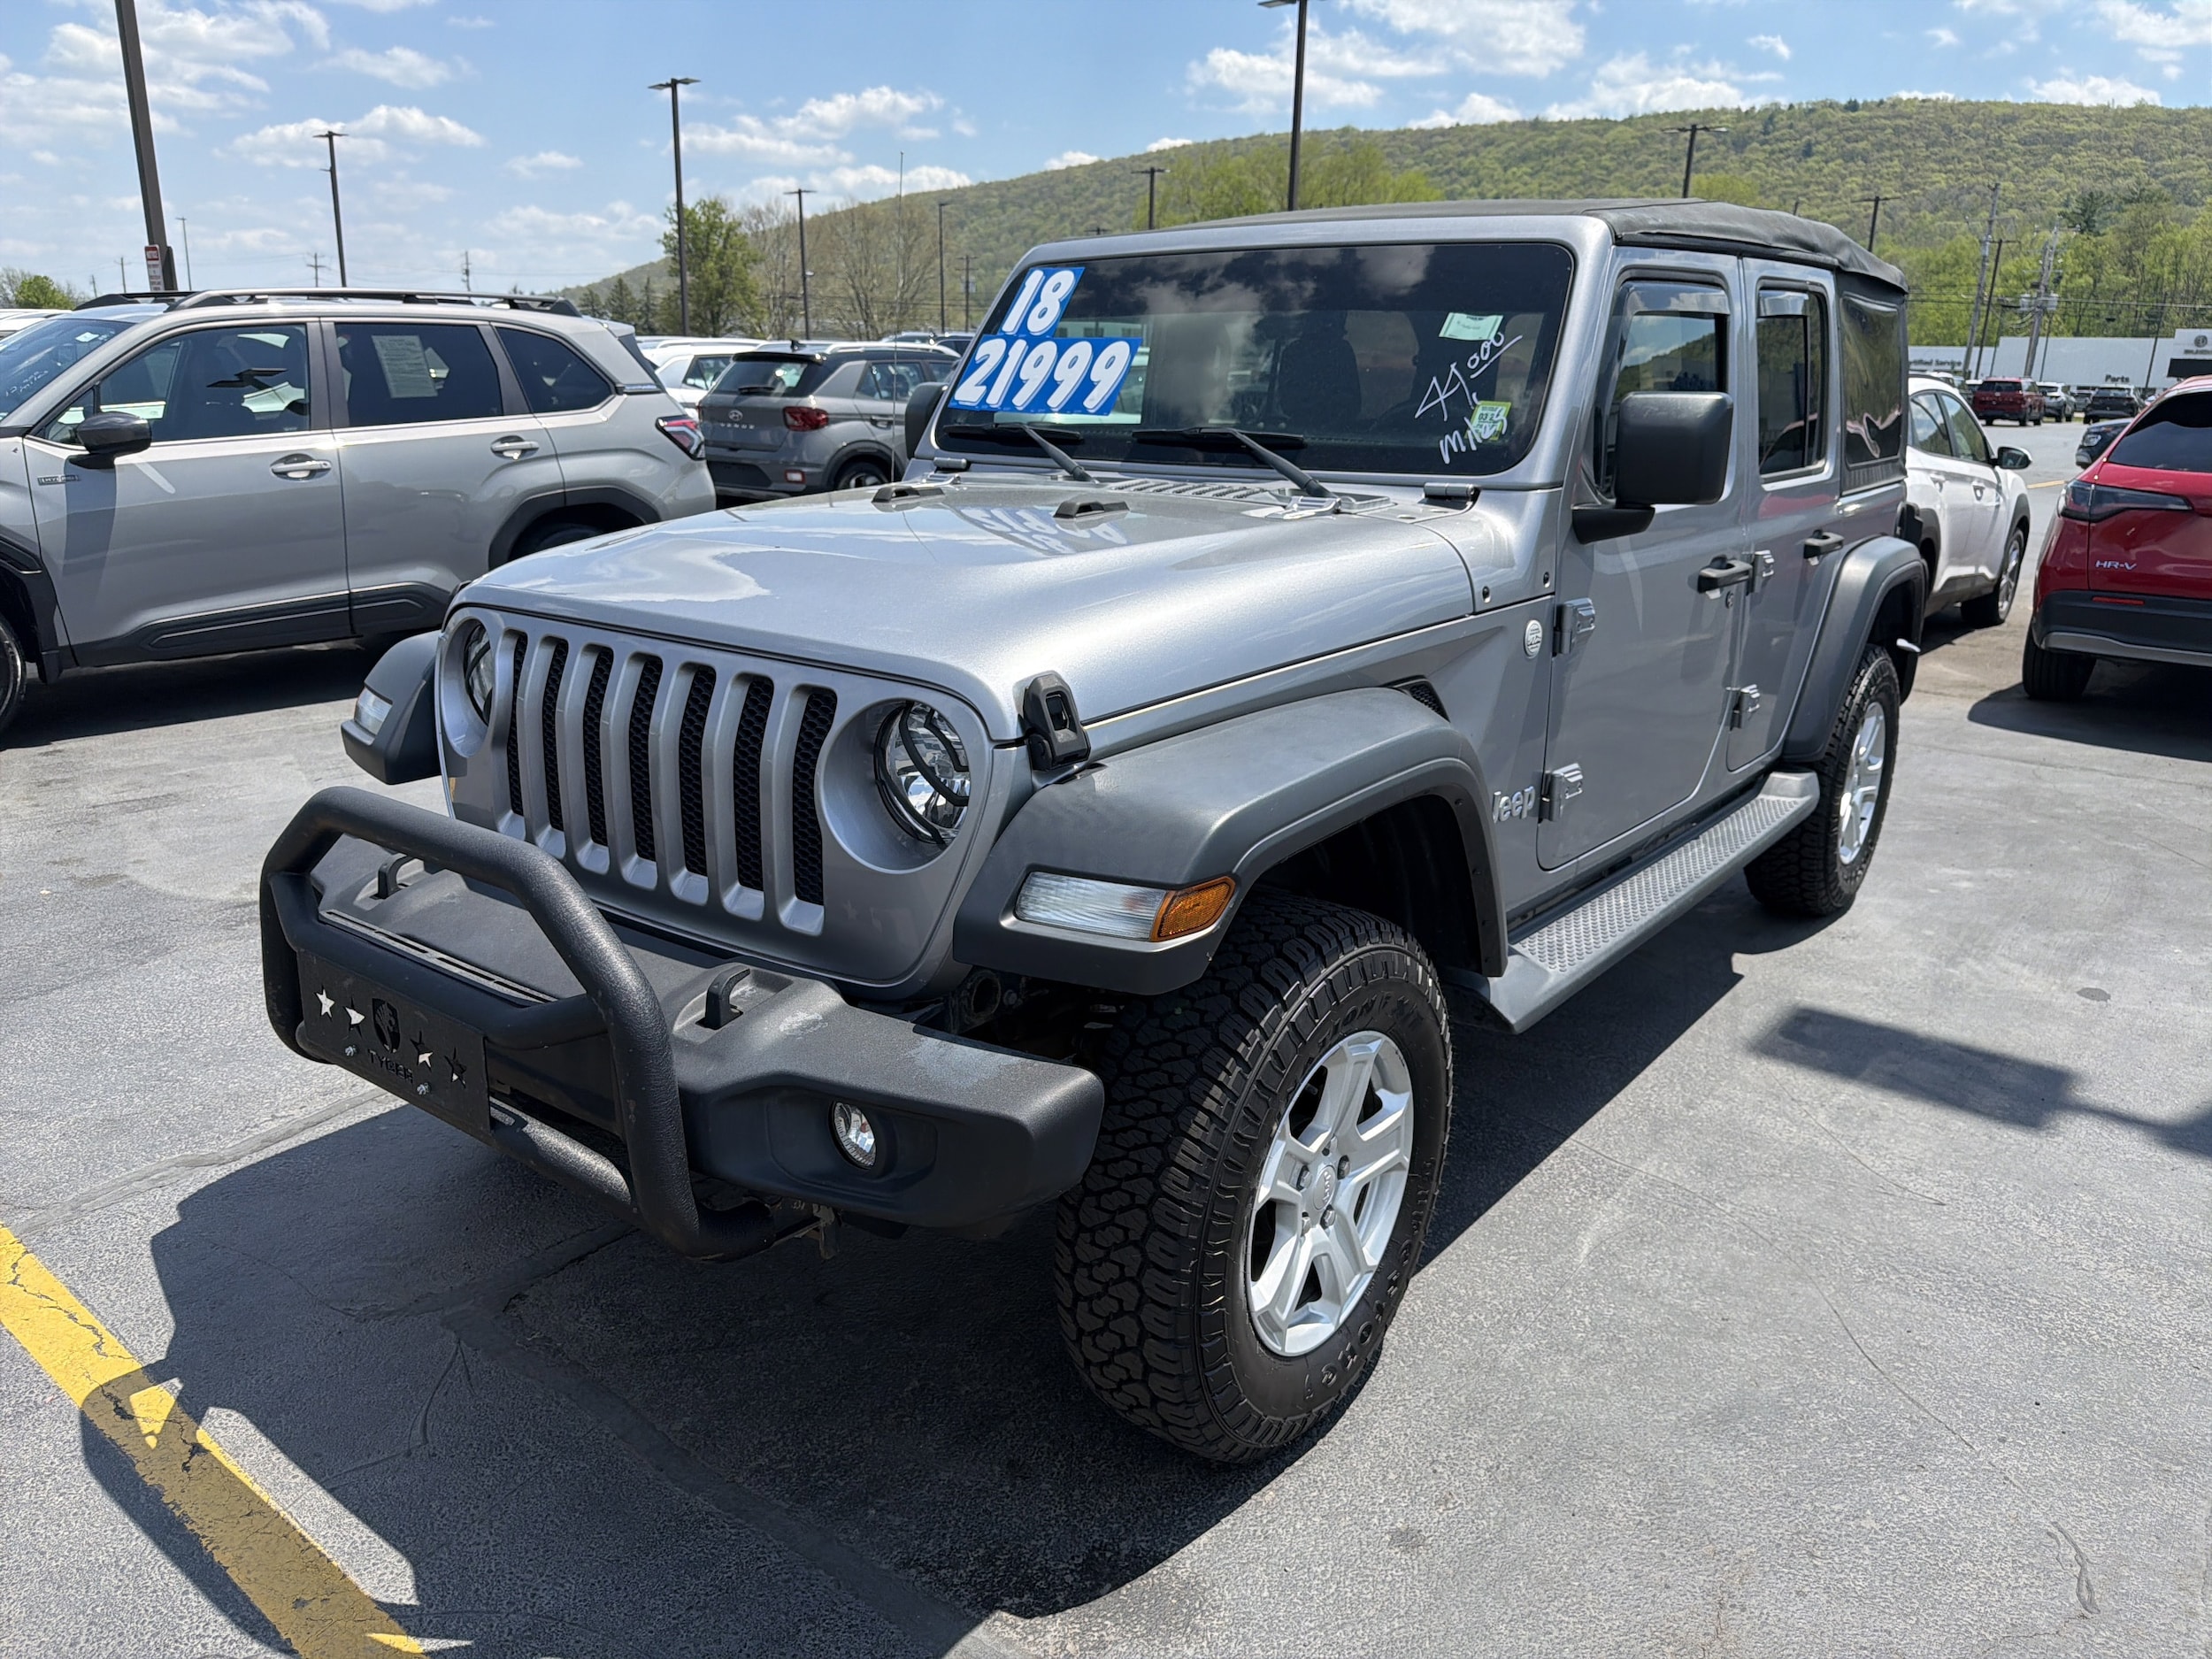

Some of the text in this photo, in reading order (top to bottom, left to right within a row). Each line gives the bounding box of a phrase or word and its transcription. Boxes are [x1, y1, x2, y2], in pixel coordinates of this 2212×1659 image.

[1002, 269, 1076, 336] 18
[954, 338, 1132, 413] 21999
[2105, 374, 2130, 383] Parts
[2095, 560, 2138, 571] HR-V
[1492, 786, 1535, 824] Jeep
[368, 1048, 414, 1084] TYGER
